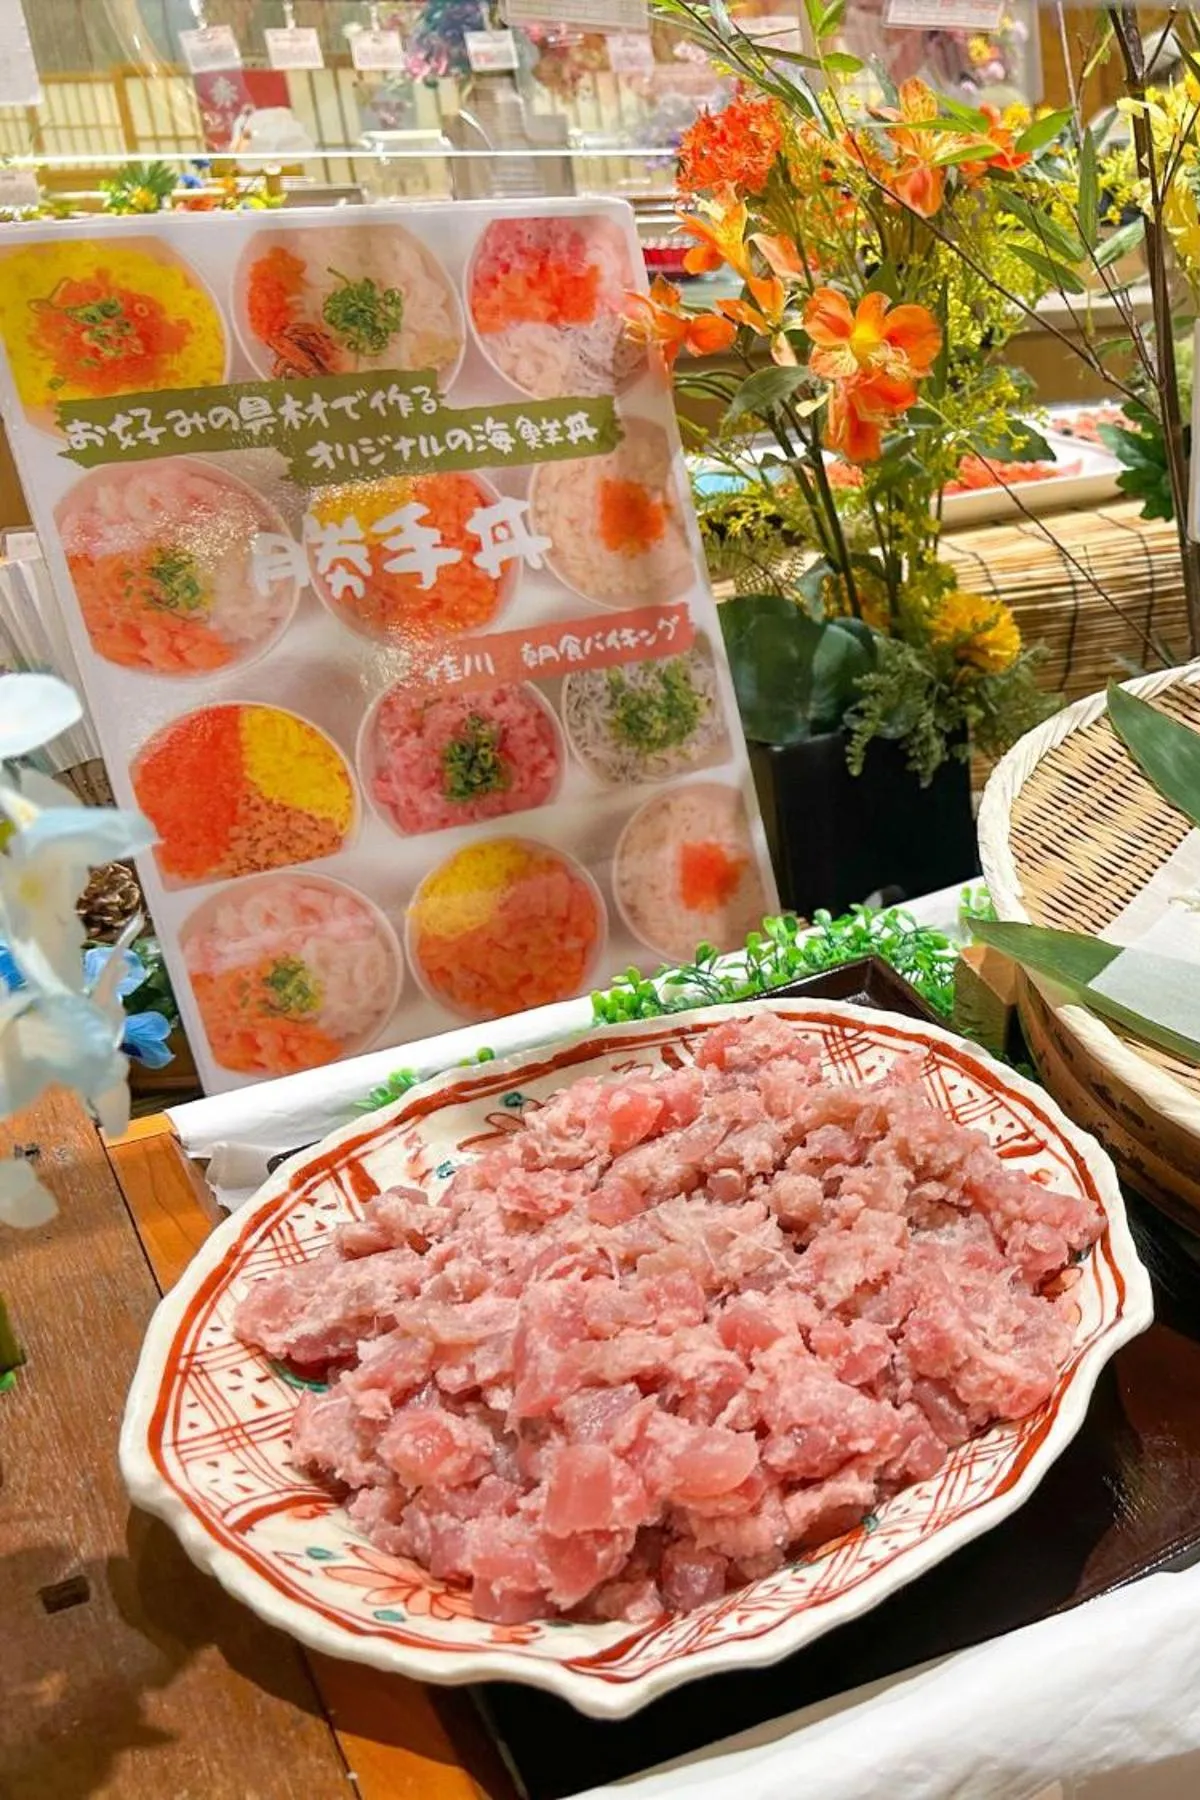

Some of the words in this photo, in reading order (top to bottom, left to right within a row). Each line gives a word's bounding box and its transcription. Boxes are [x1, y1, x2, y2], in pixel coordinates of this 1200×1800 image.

[66, 384, 438, 450] お好みの具材で作る
[306, 411, 599, 470] オリジナルの海鮮丼
[251, 496, 552, 600] 勝手丼
[520, 614, 681, 669] 朝食バイキング
